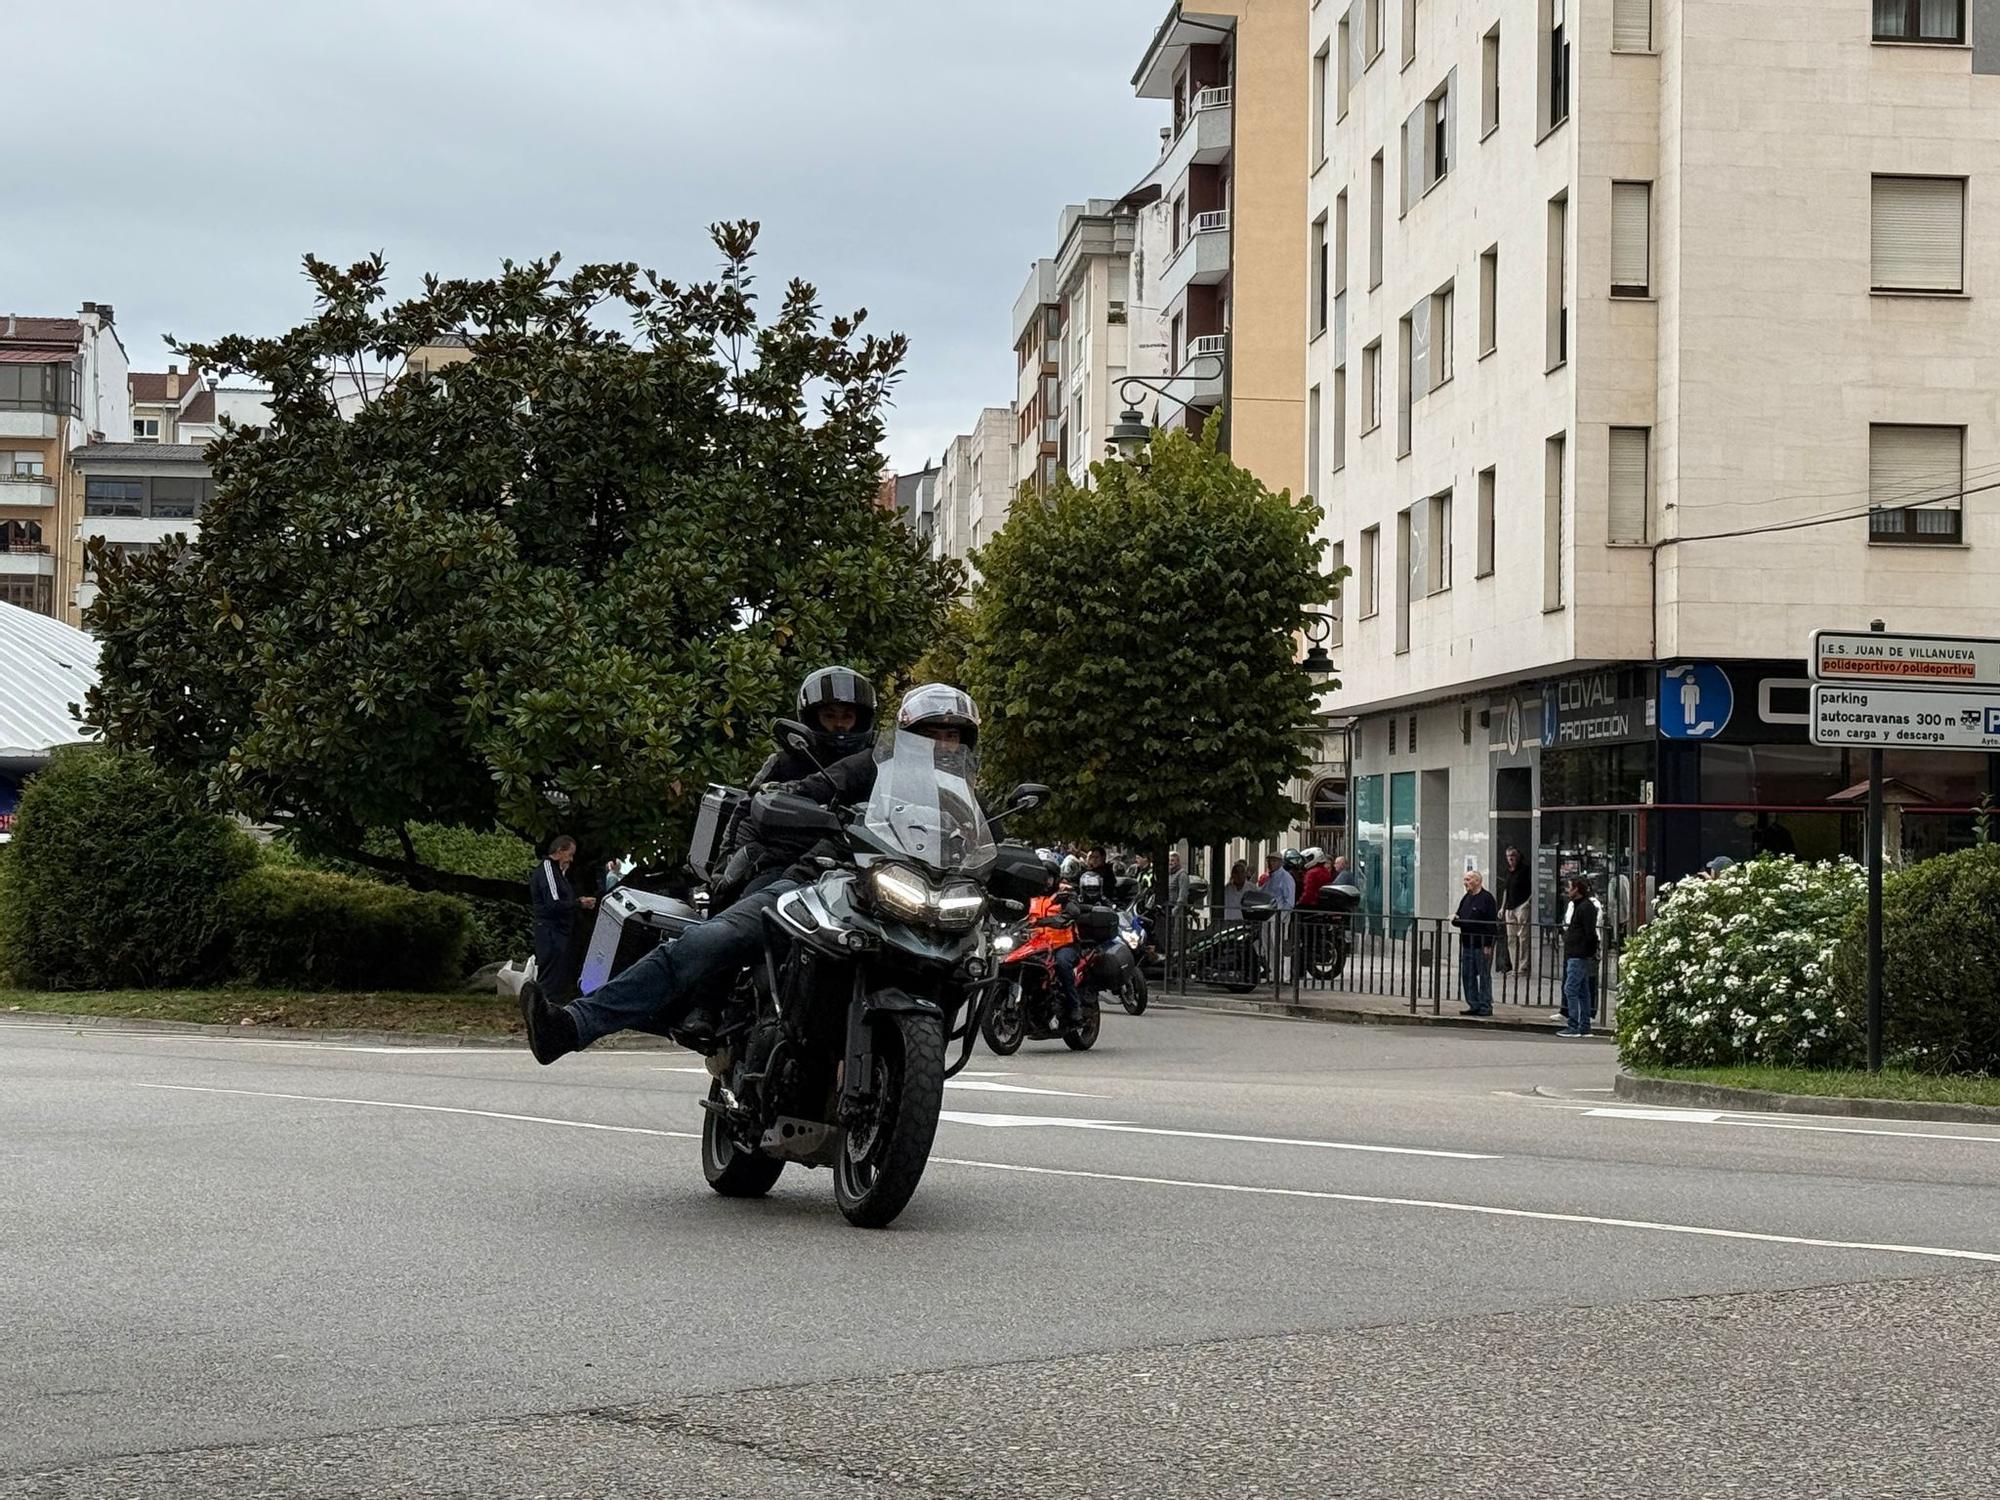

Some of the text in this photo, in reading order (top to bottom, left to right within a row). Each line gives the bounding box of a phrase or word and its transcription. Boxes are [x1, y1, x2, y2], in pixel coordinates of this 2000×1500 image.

[1821, 644, 1976, 660] I.E.S. JUAN DE VILLANUEVA
[1558, 673, 1615, 712] COVAL
[1820, 692, 1869, 707] parking
[1559, 710, 1630, 743] PROTECCIÓN
[1820, 711, 1957, 727] autocaravanas 300 m
[1820, 728, 1946, 743] con carga y descarga
